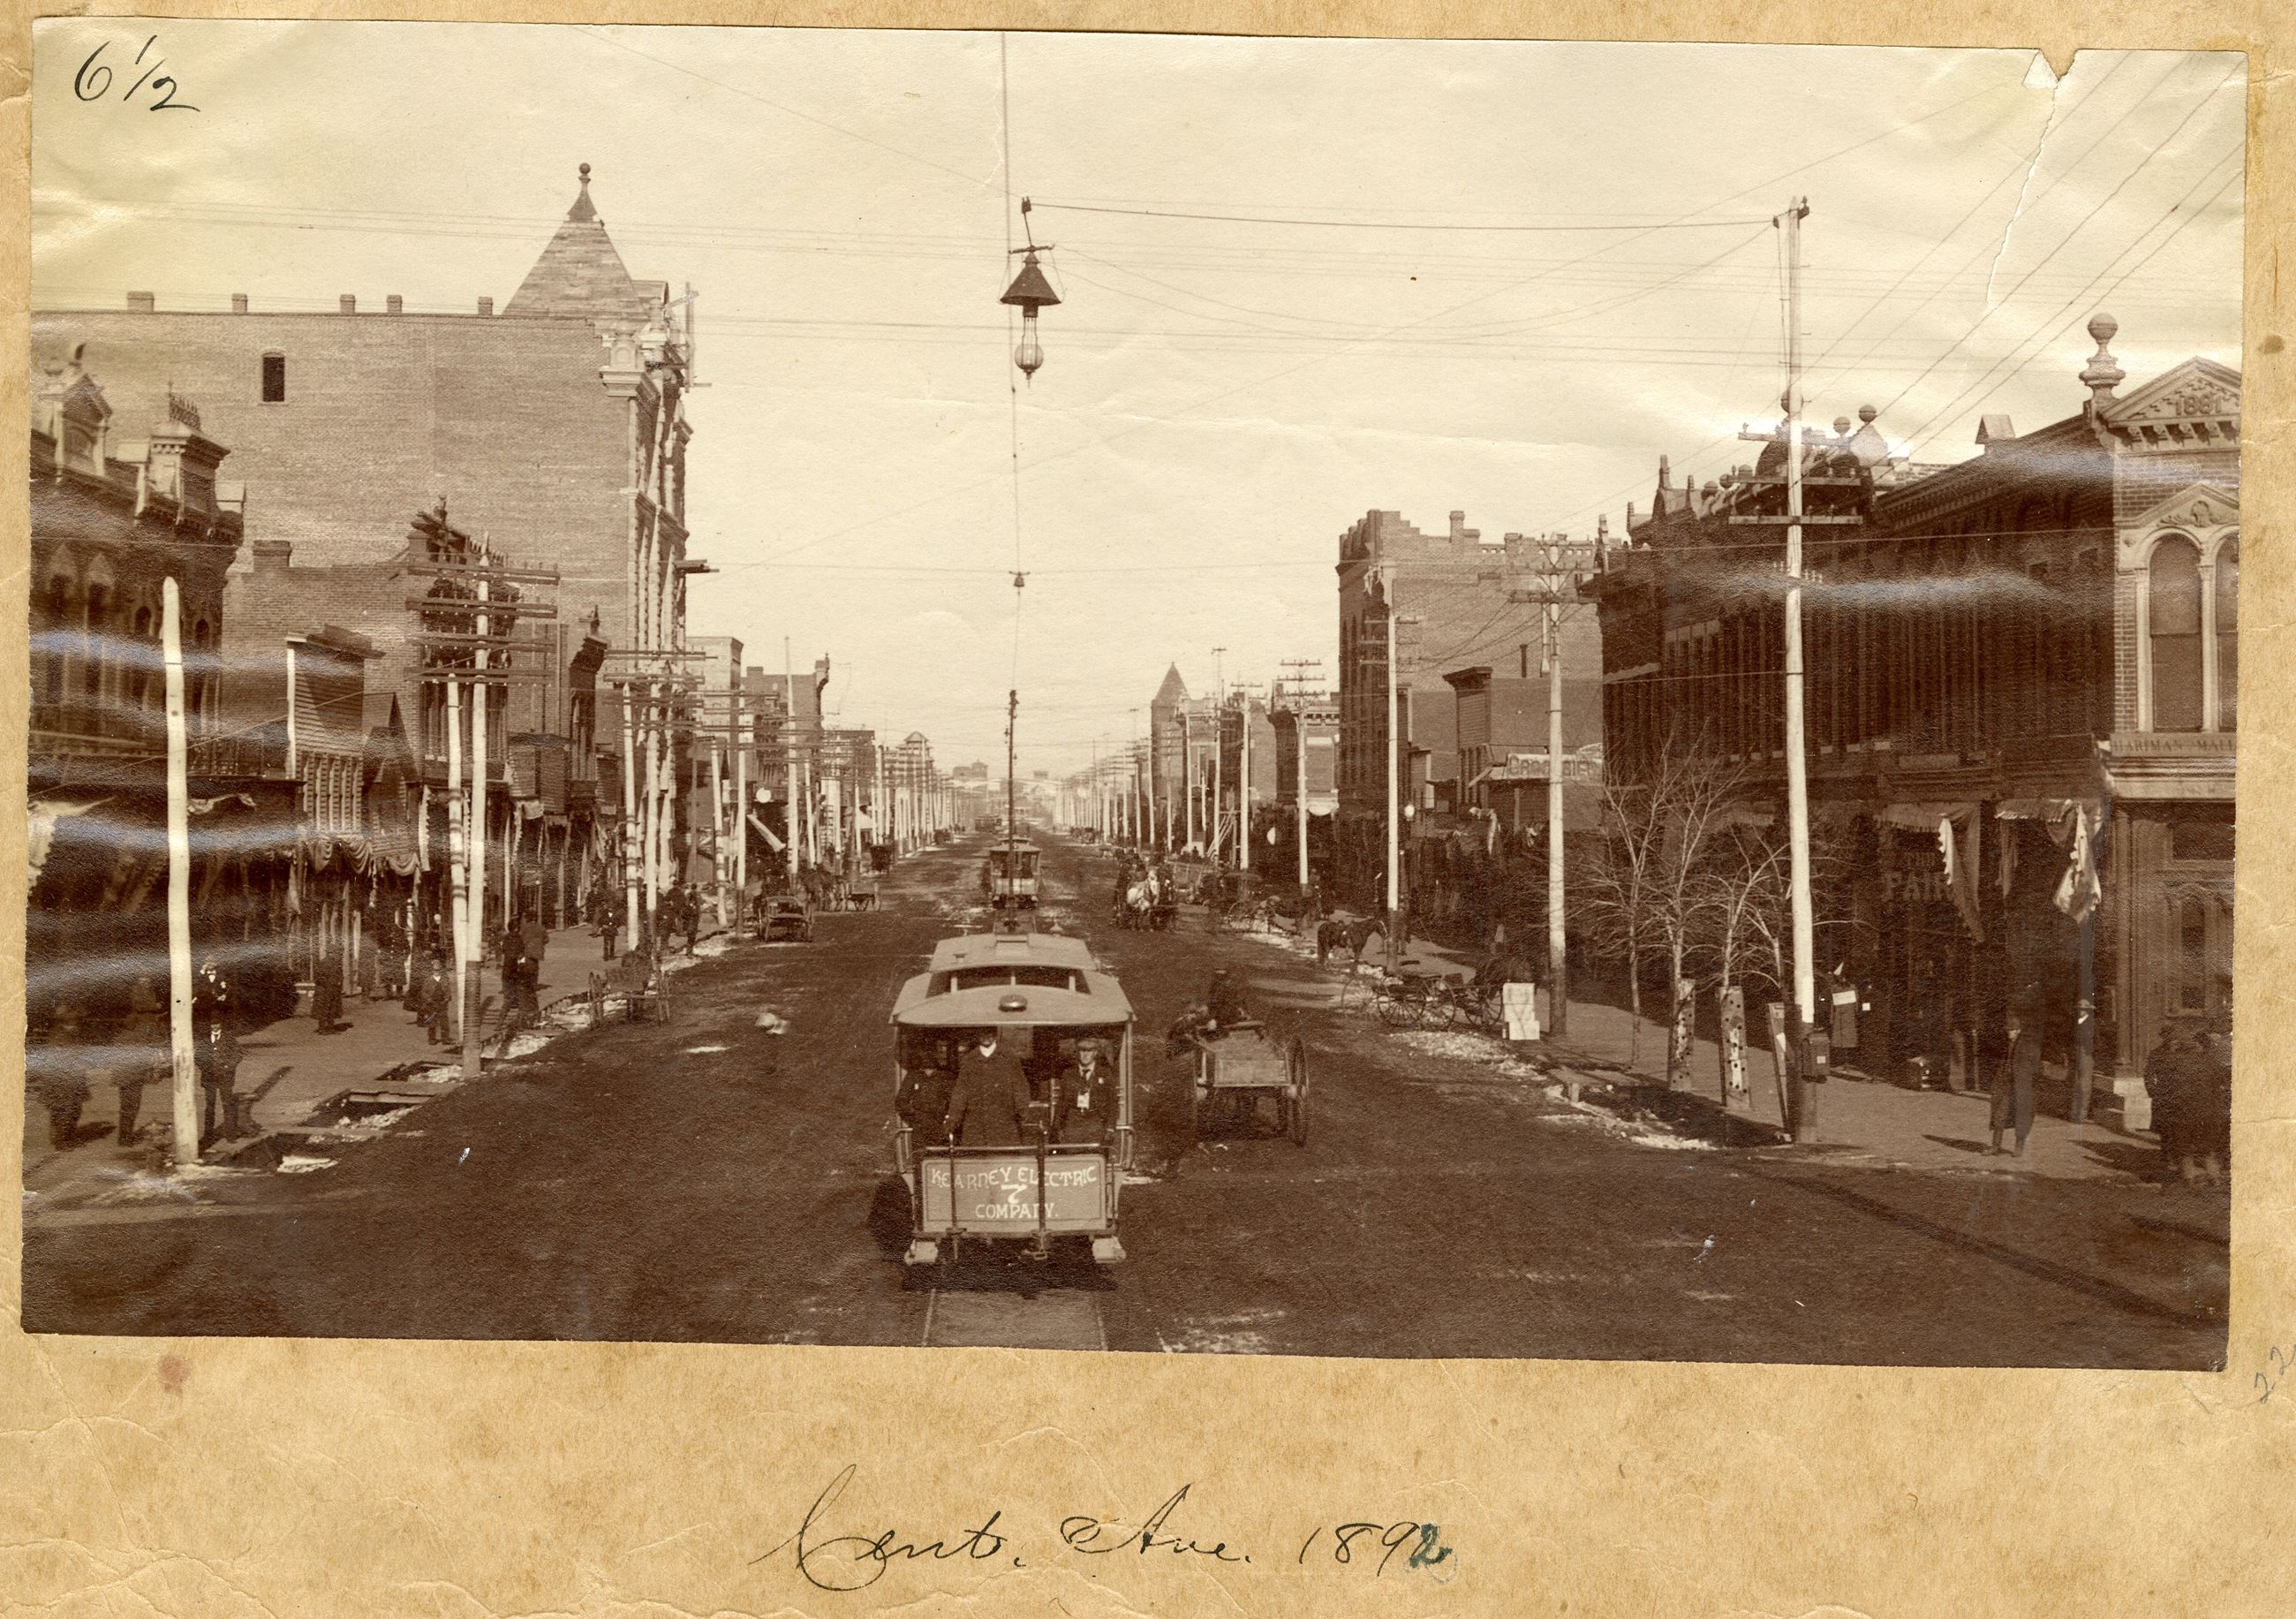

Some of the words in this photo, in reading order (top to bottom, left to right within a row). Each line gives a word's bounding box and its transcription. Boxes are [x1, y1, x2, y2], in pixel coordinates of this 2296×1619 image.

[2176, 394, 2222, 416] 1881
[931, 1165, 1012, 1192] KEARNEY
[1001, 1183, 1028, 1205] 7
[1061, 1482, 1252, 1564] Ave.
[1298, 1521, 1454, 1578] 1892
